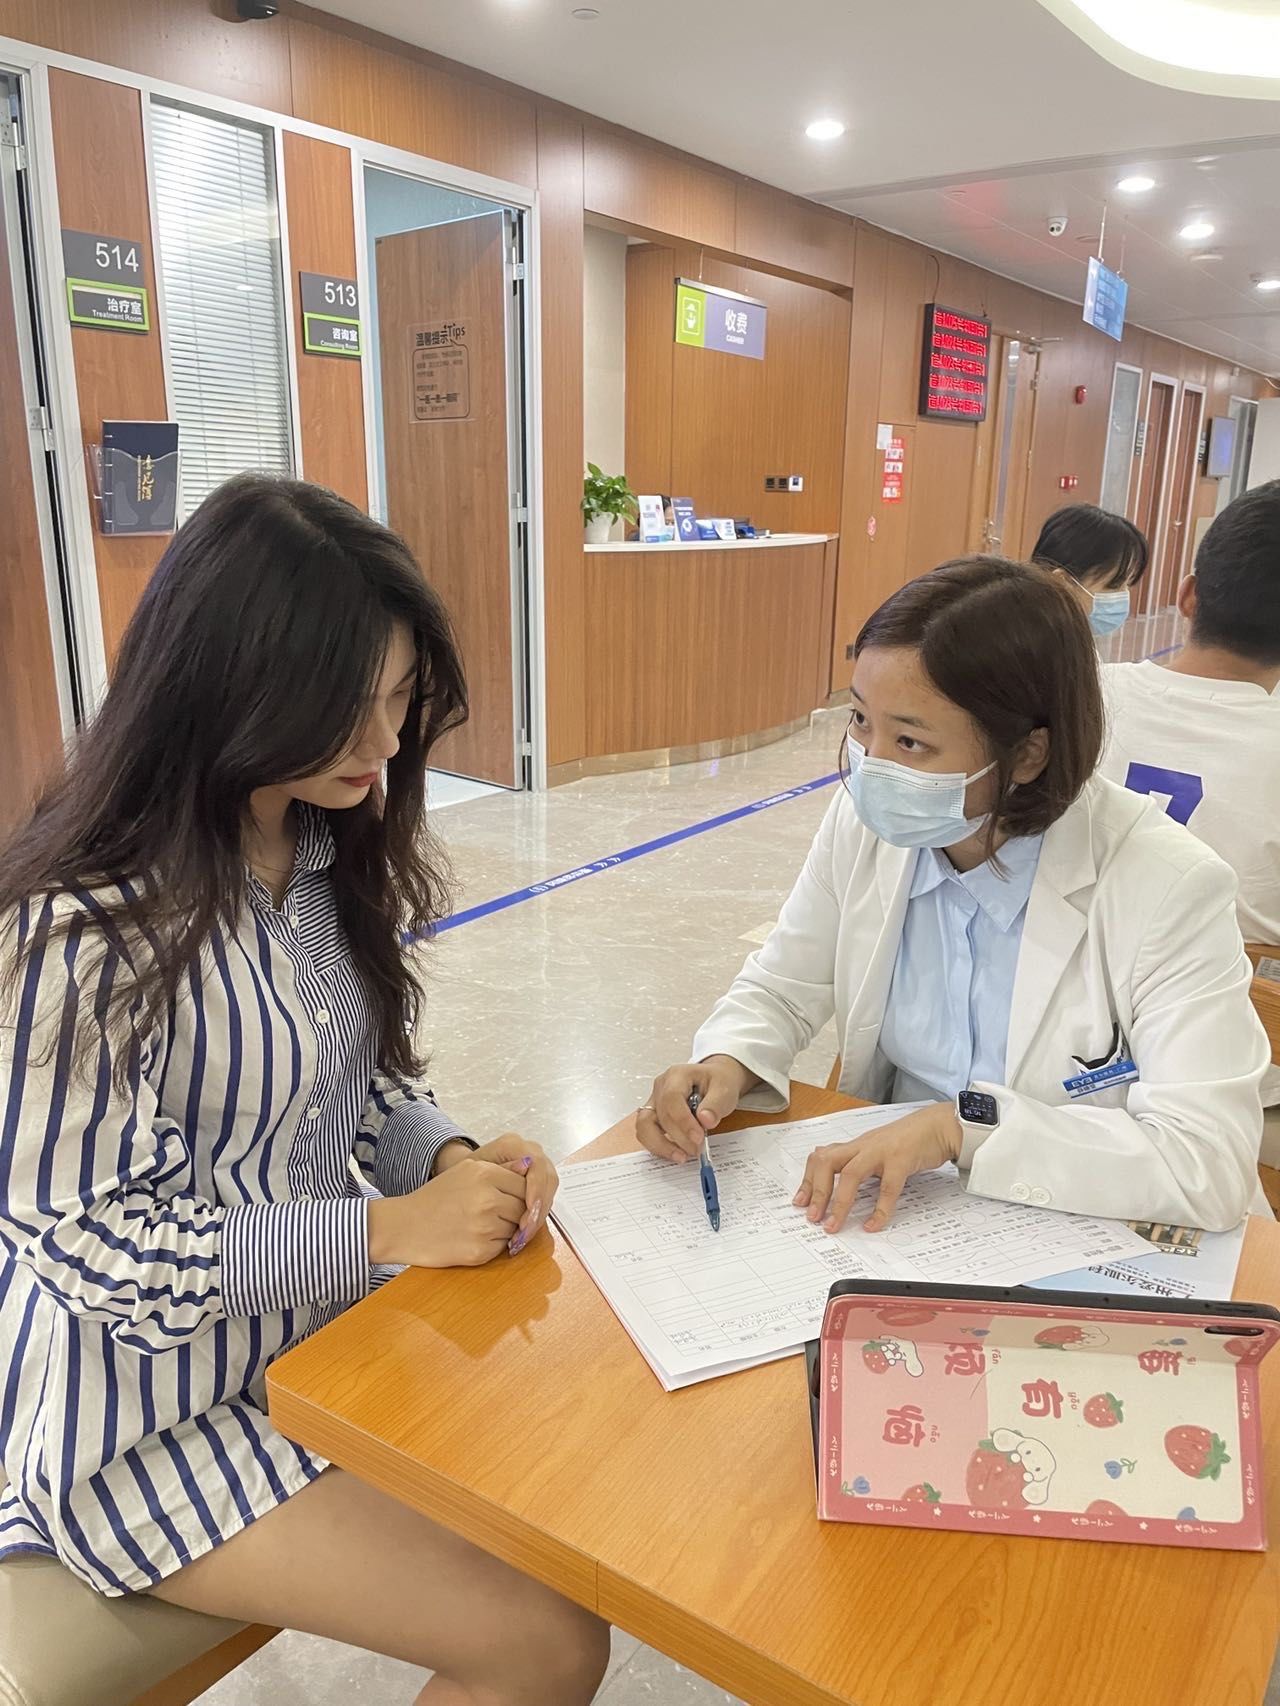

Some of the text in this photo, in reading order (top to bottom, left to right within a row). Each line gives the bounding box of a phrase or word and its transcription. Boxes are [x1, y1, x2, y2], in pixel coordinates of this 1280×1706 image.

[96, 242, 139, 272] 514
[324, 281, 357, 307] 513
[92, 309, 144, 323] Treatment Room
[107, 298, 142, 316] 治疗室
[725, 308, 748, 334] 收费
[332, 327, 358, 342] 咨询室
[447, 324, 466, 341] Tips
[944, 1341, 986, 1377] 烦
[991, 1347, 1000, 1365] fán
[1021, 1378, 1065, 1420] 有
[881, 1403, 926, 1449] 恼
[929, 1424, 939, 1443] nǎo
